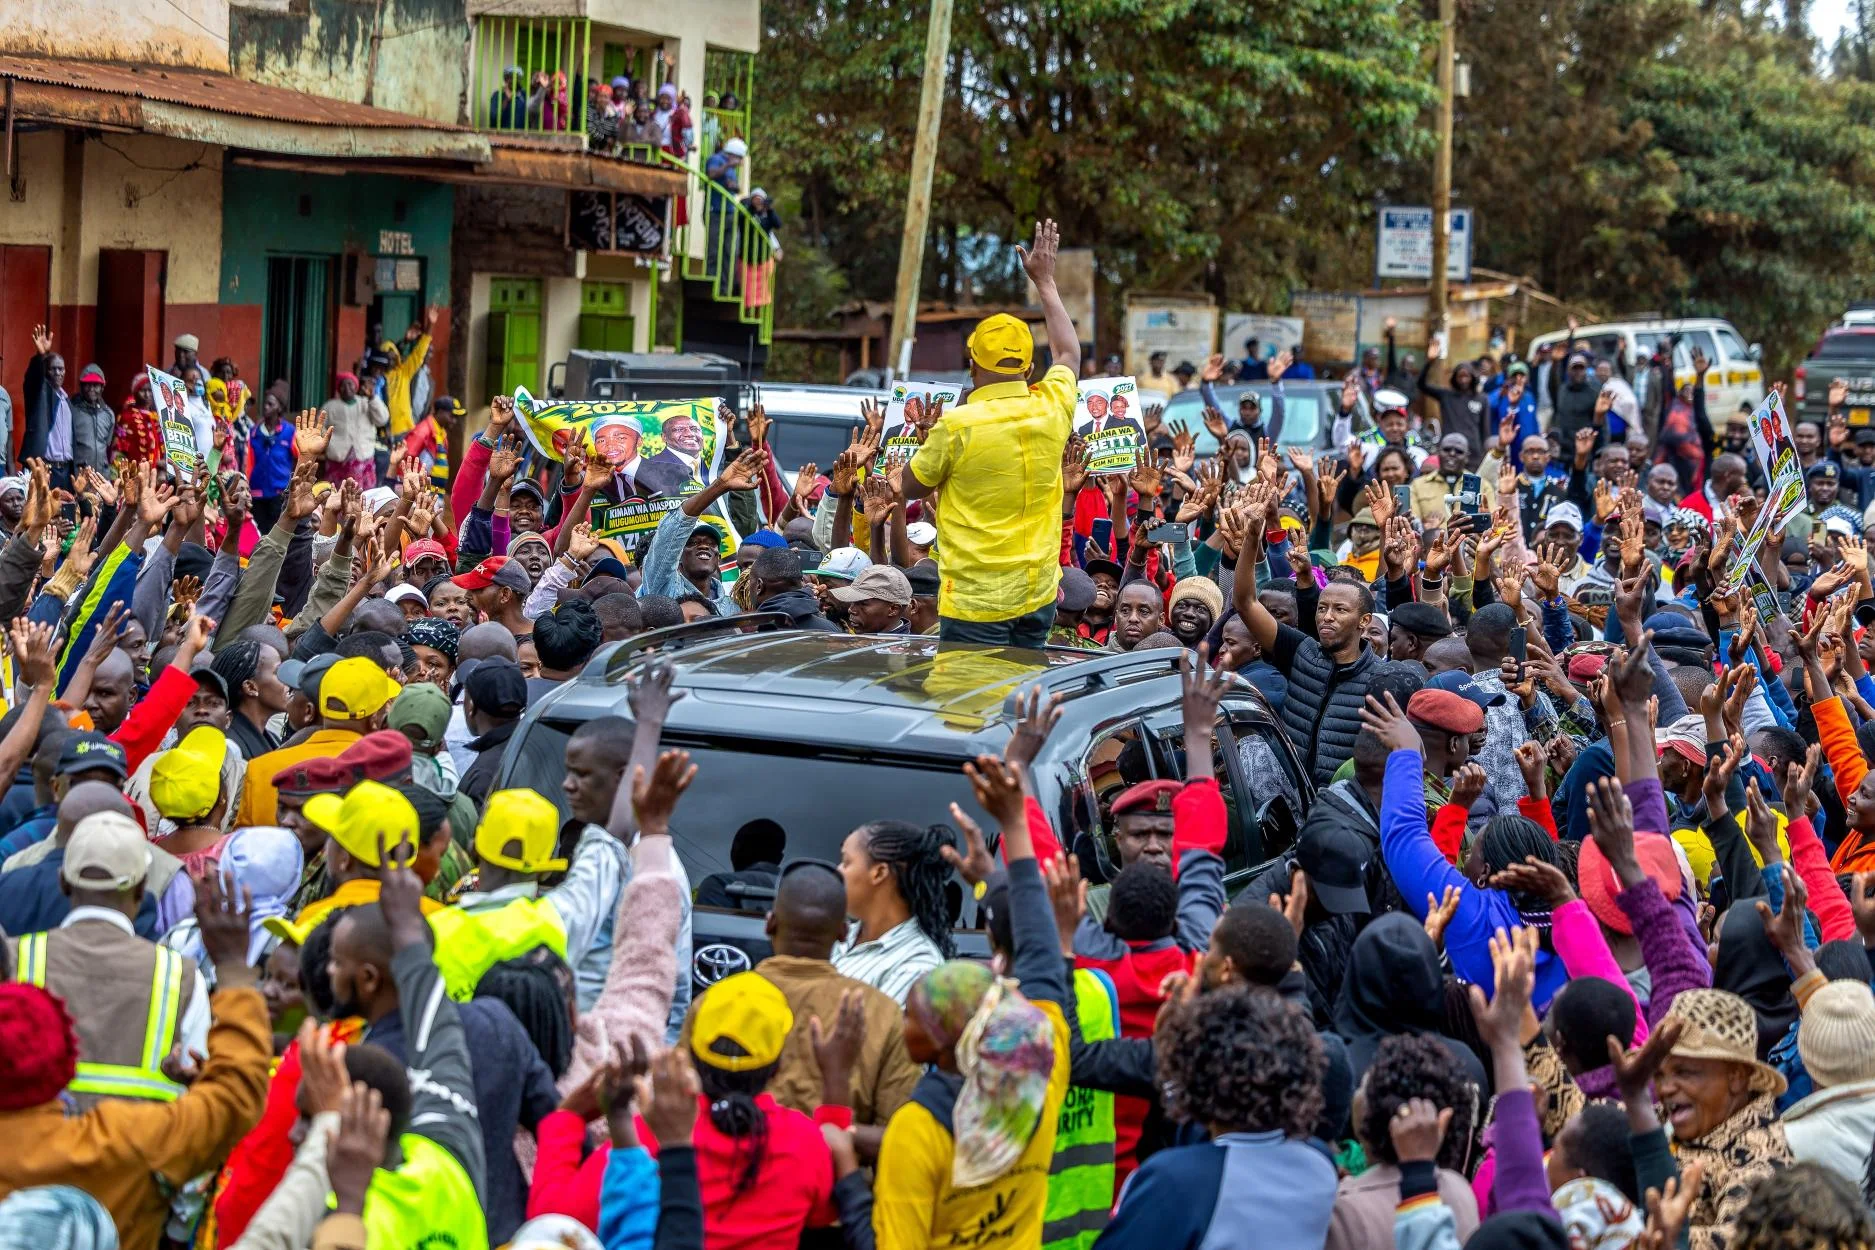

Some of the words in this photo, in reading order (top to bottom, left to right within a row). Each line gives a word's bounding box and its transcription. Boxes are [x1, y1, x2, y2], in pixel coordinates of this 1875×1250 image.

[379, 230, 415, 255] HOTEL
[1116, 383, 1132, 393] 2027
[572, 401, 657, 419] 2027
[166, 429, 196, 450] BETTY
[892, 437, 919, 445] KIJANA
[1086, 432, 1141, 453] BETTY
[1087, 429, 1117, 441] KIJANA
[1118, 427, 1132, 435] WA
[886, 445, 919, 458] BET
[1093, 460, 1106, 468] KIM
[609, 505, 635, 519] KIMANI
[635, 503, 648, 515] WA
[649, 499, 683, 513] DIASPOR
[609, 514, 649, 529] MUGUMOINI
[650, 510, 668, 522] WAR
[611, 532, 640, 551] AZI
